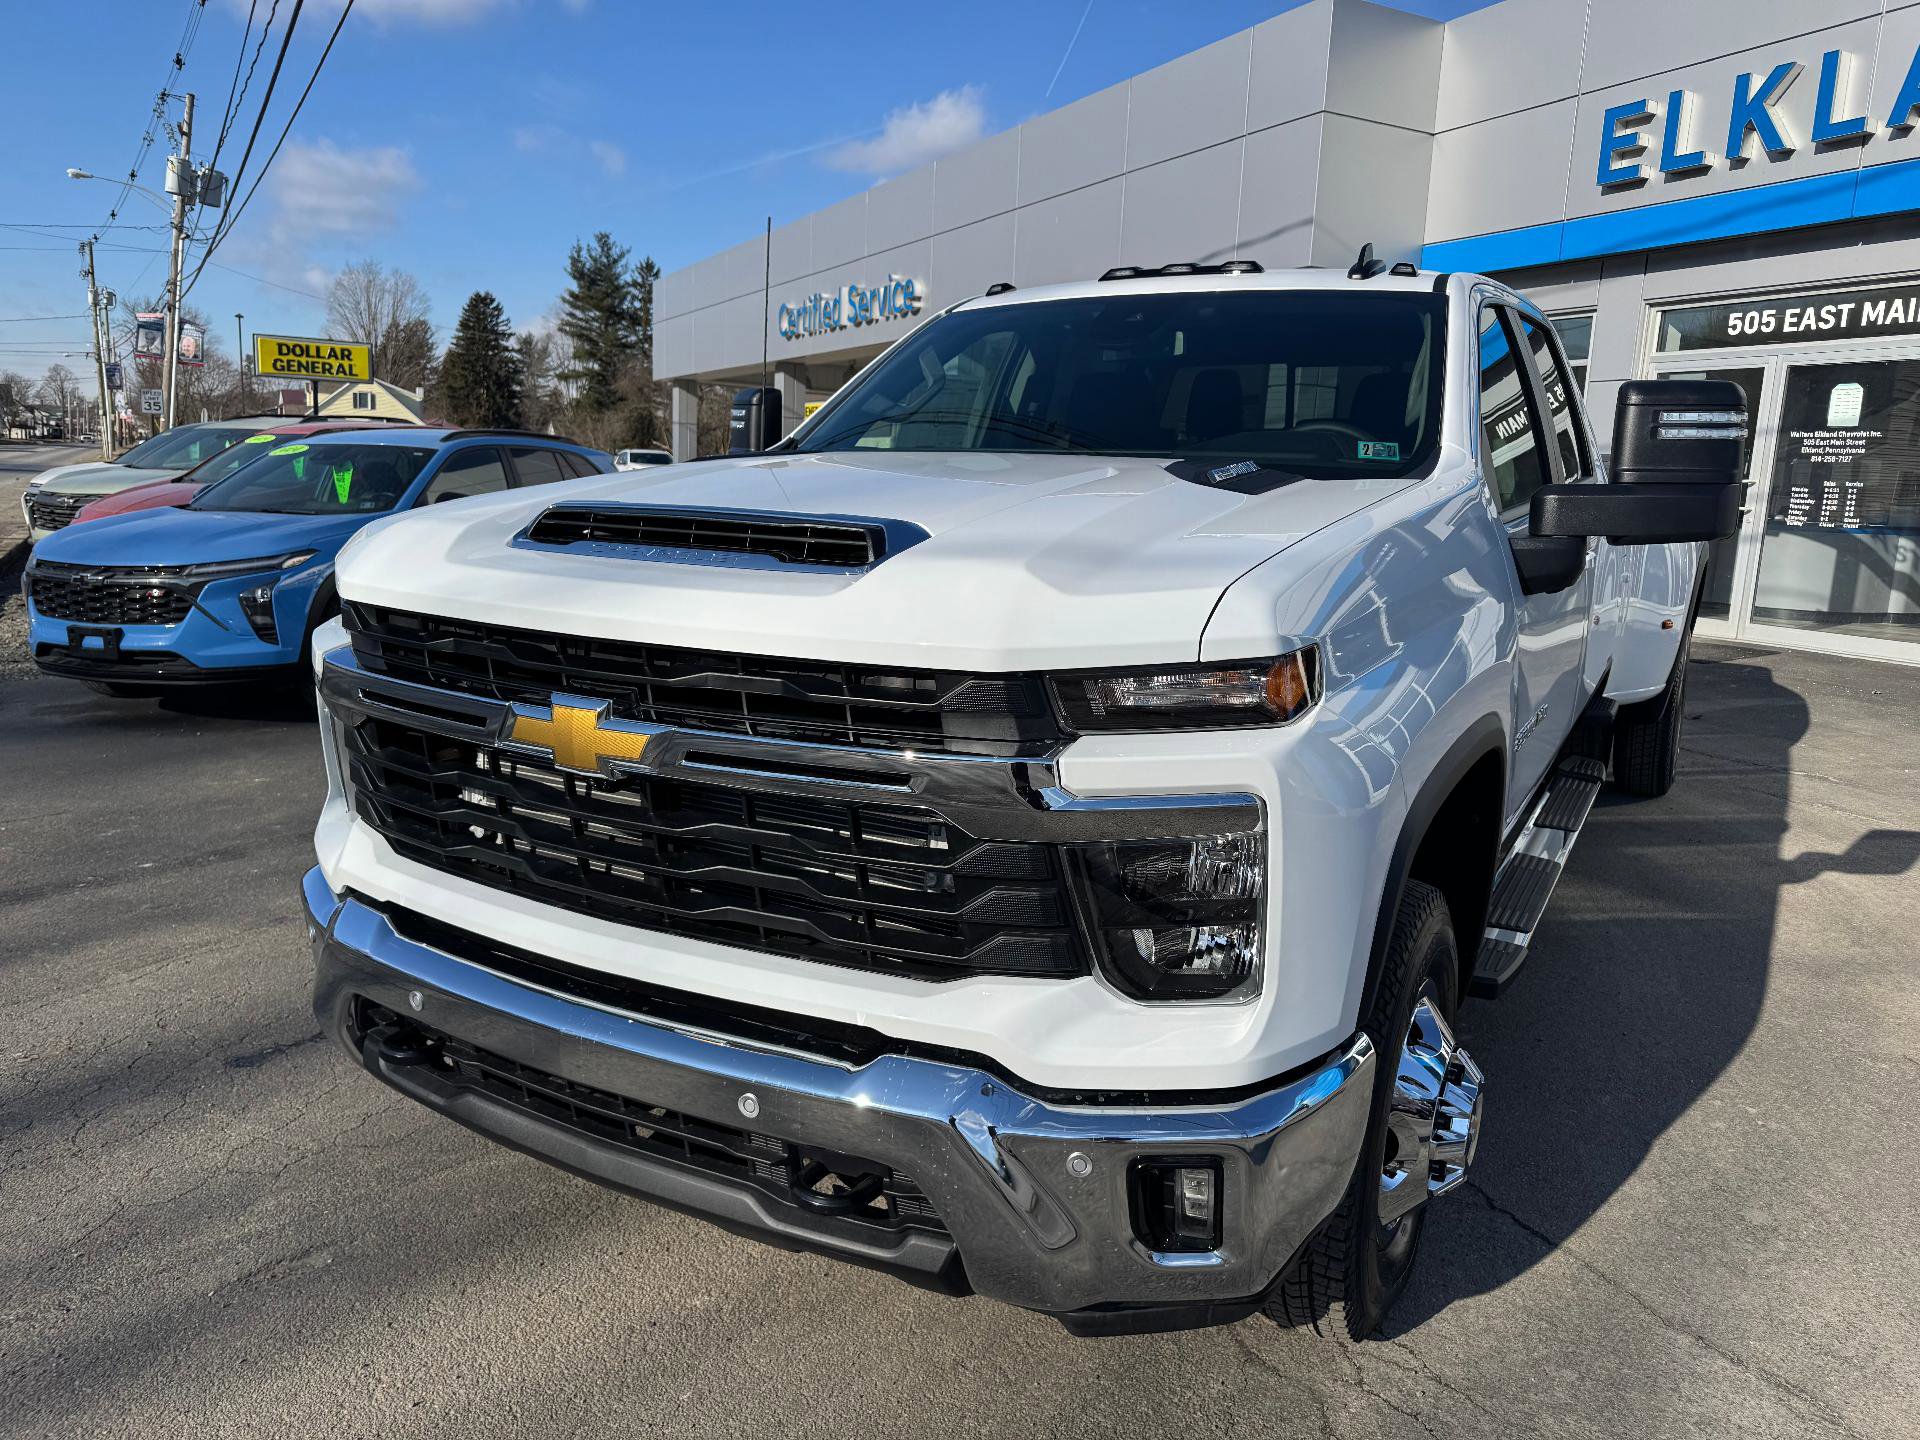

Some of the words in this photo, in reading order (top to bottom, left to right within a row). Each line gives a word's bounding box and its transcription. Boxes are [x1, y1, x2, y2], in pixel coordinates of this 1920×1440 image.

[779, 286, 842, 337] Certified
[847, 272, 915, 324] Service
[1727, 309, 1776, 335] 505
[1783, 303, 1855, 332] EAST
[1861, 297, 1920, 326] MAI
[277, 343, 353, 361] DOLLAR
[272, 358, 358, 377] GENERAL
[144, 401, 162, 411] 35
[1839, 430, 1869, 438] Chevrolet
[1363, 443, 1371, 456] 2
